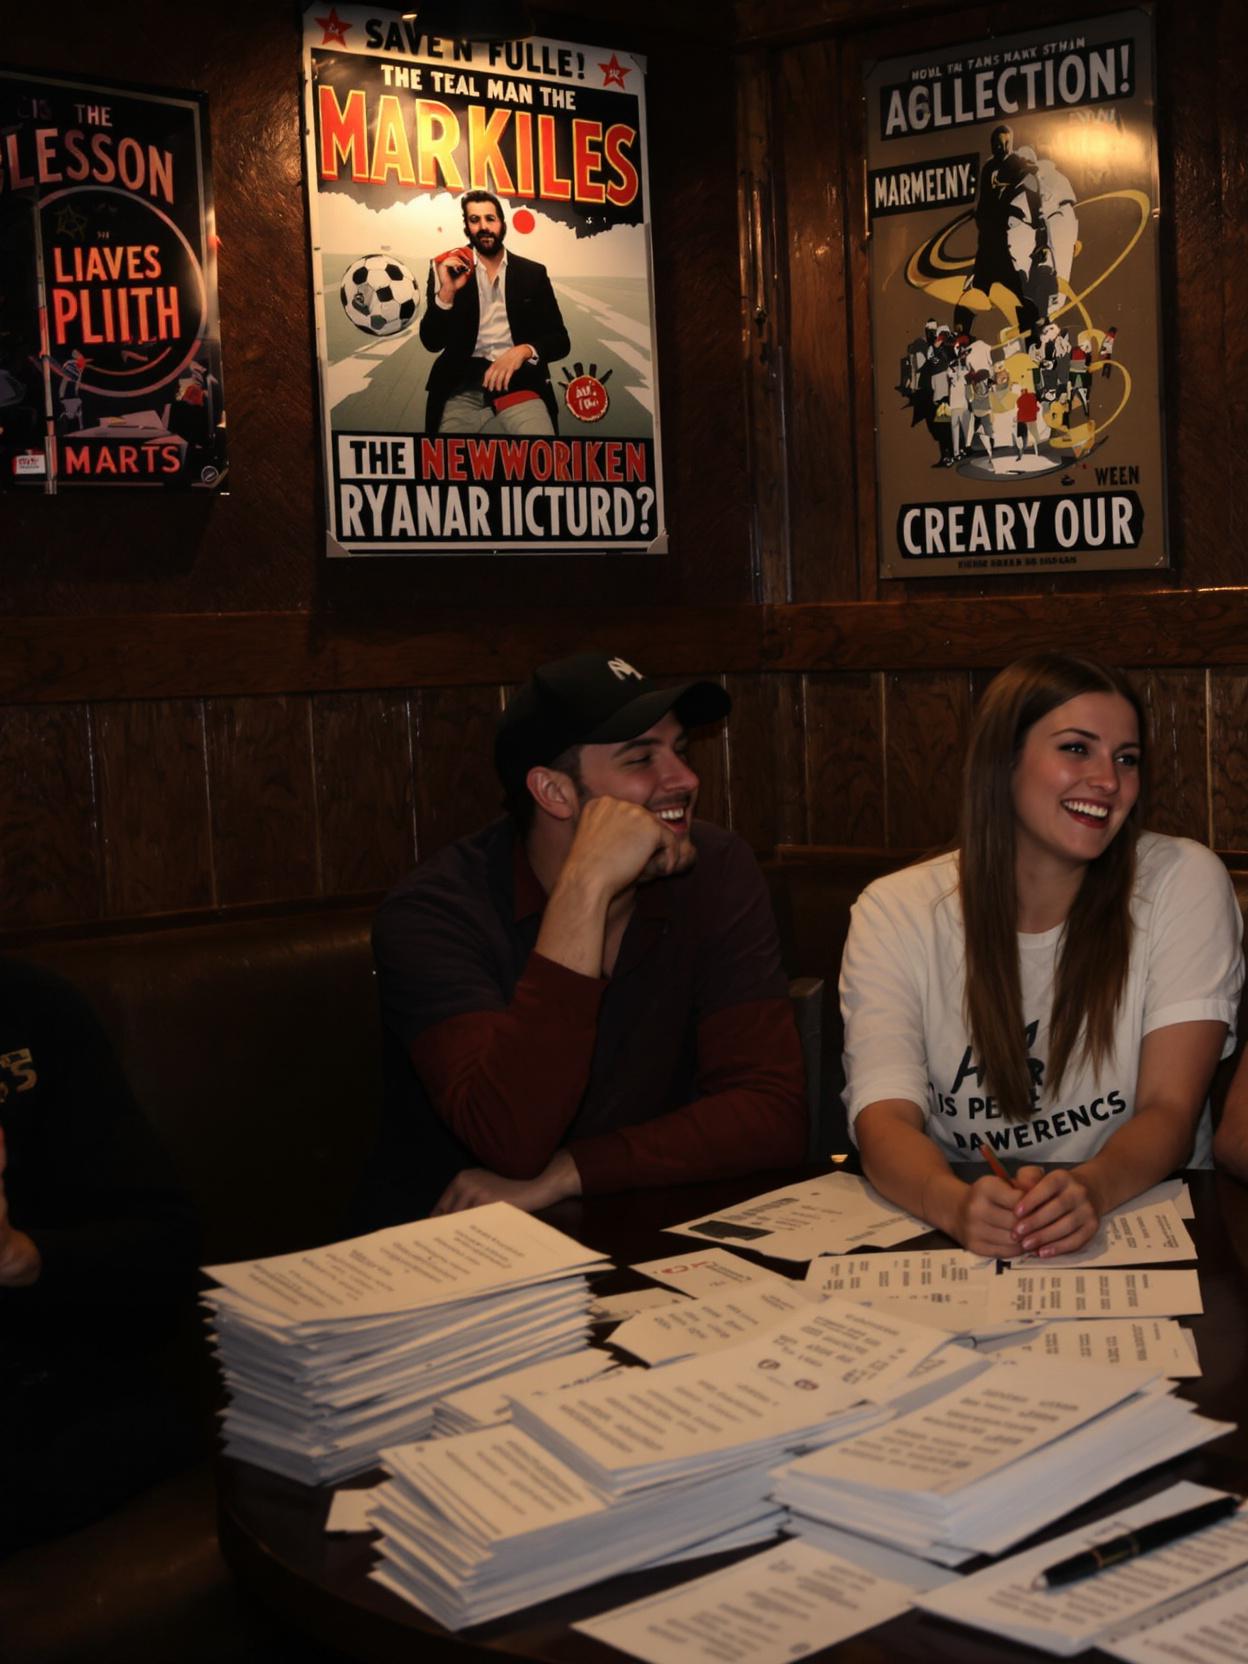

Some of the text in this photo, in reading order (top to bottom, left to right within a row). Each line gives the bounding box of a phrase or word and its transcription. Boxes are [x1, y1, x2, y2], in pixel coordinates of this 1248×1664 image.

[489, 41, 584, 79] FULLE!
[381, 64, 577, 110] THE TEAL MAN THE
[72, 103, 113, 127] THE
[318, 85, 639, 207] MARKILES
[52, 244, 162, 283] LIAVES
[64, 445, 181, 475] MARTS
[350, 438, 647, 483] THE NEWWORIKEN
[1095, 466, 1140, 486] WEEN
[340, 484, 491, 537] RYANAR
[902, 496, 1135, 556] CREARY OUR
